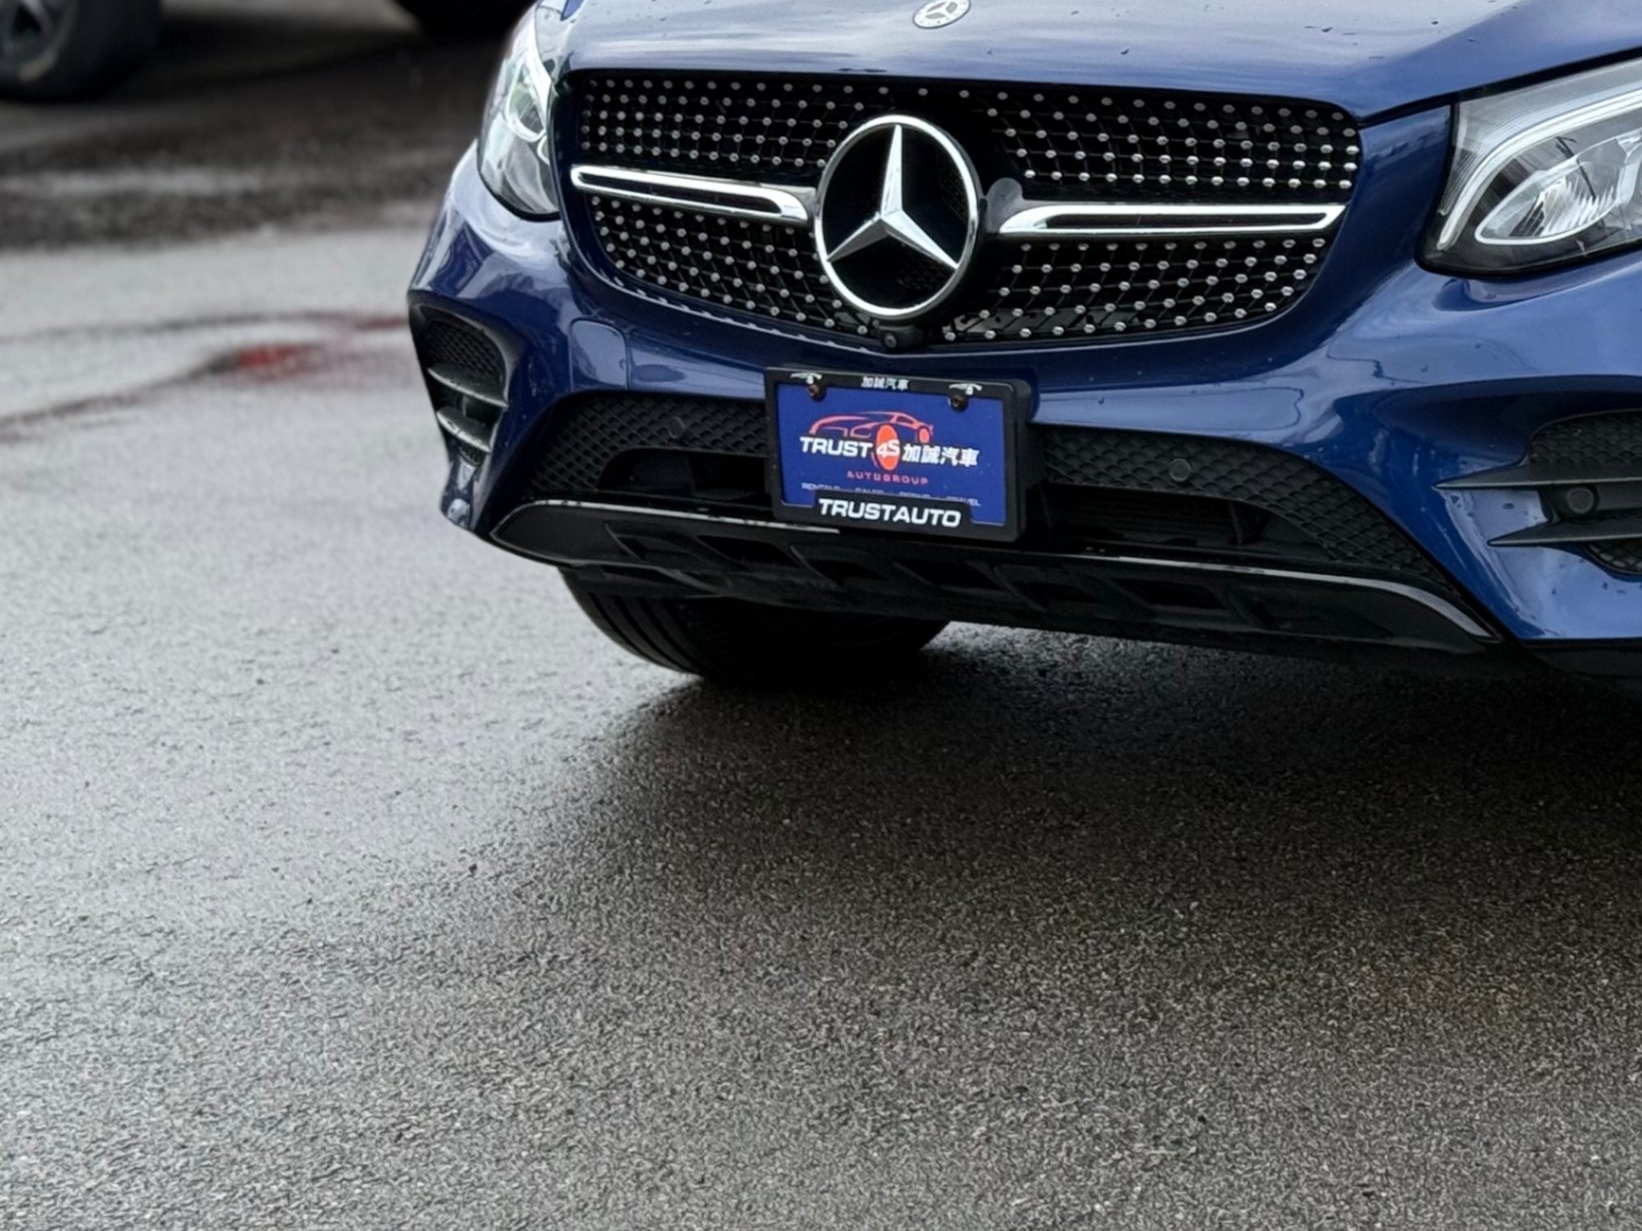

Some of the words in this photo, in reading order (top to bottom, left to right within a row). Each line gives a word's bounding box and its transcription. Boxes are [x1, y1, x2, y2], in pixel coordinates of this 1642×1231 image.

[800, 436, 873, 458] TRUST
[876, 438, 900, 458] 4S
[902, 443, 980, 467] 加誠汽車
[818, 498, 961, 527] TRUSTAUTO
